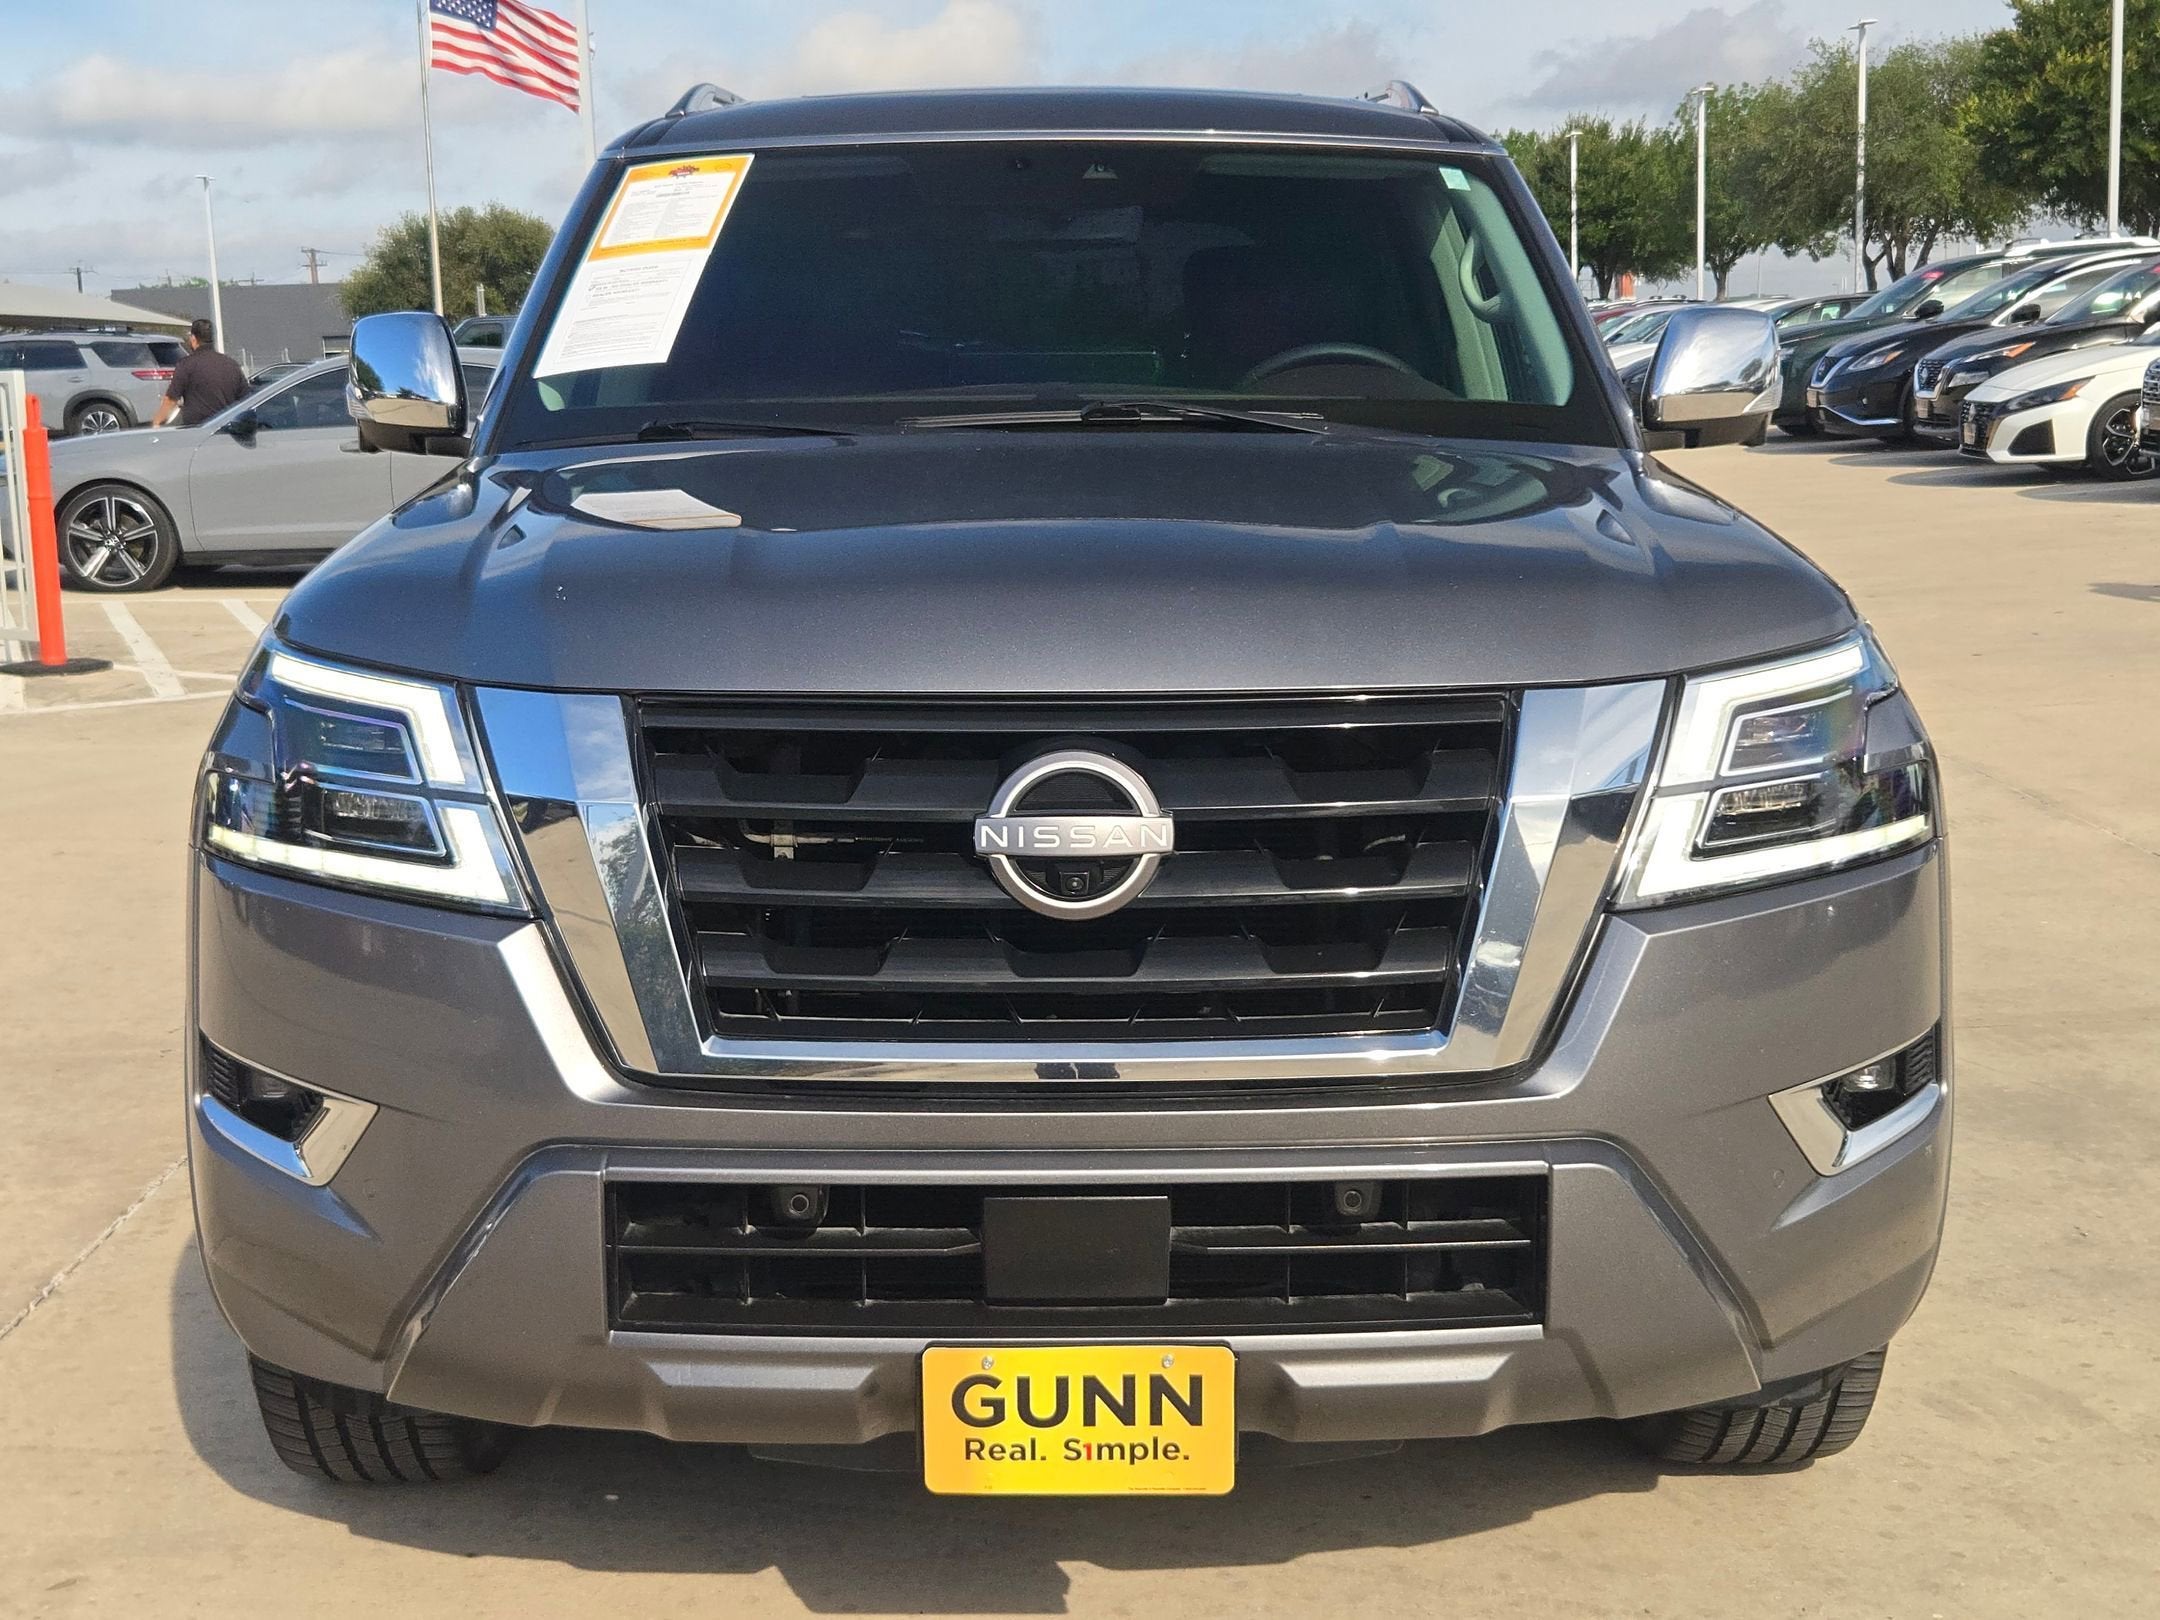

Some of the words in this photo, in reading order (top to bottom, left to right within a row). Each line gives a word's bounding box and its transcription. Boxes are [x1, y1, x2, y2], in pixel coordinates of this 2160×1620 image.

[980, 824, 1168, 848] NISSAN
[951, 1373, 1203, 1428] GUNN
[965, 1437, 1047, 1461] Real.
